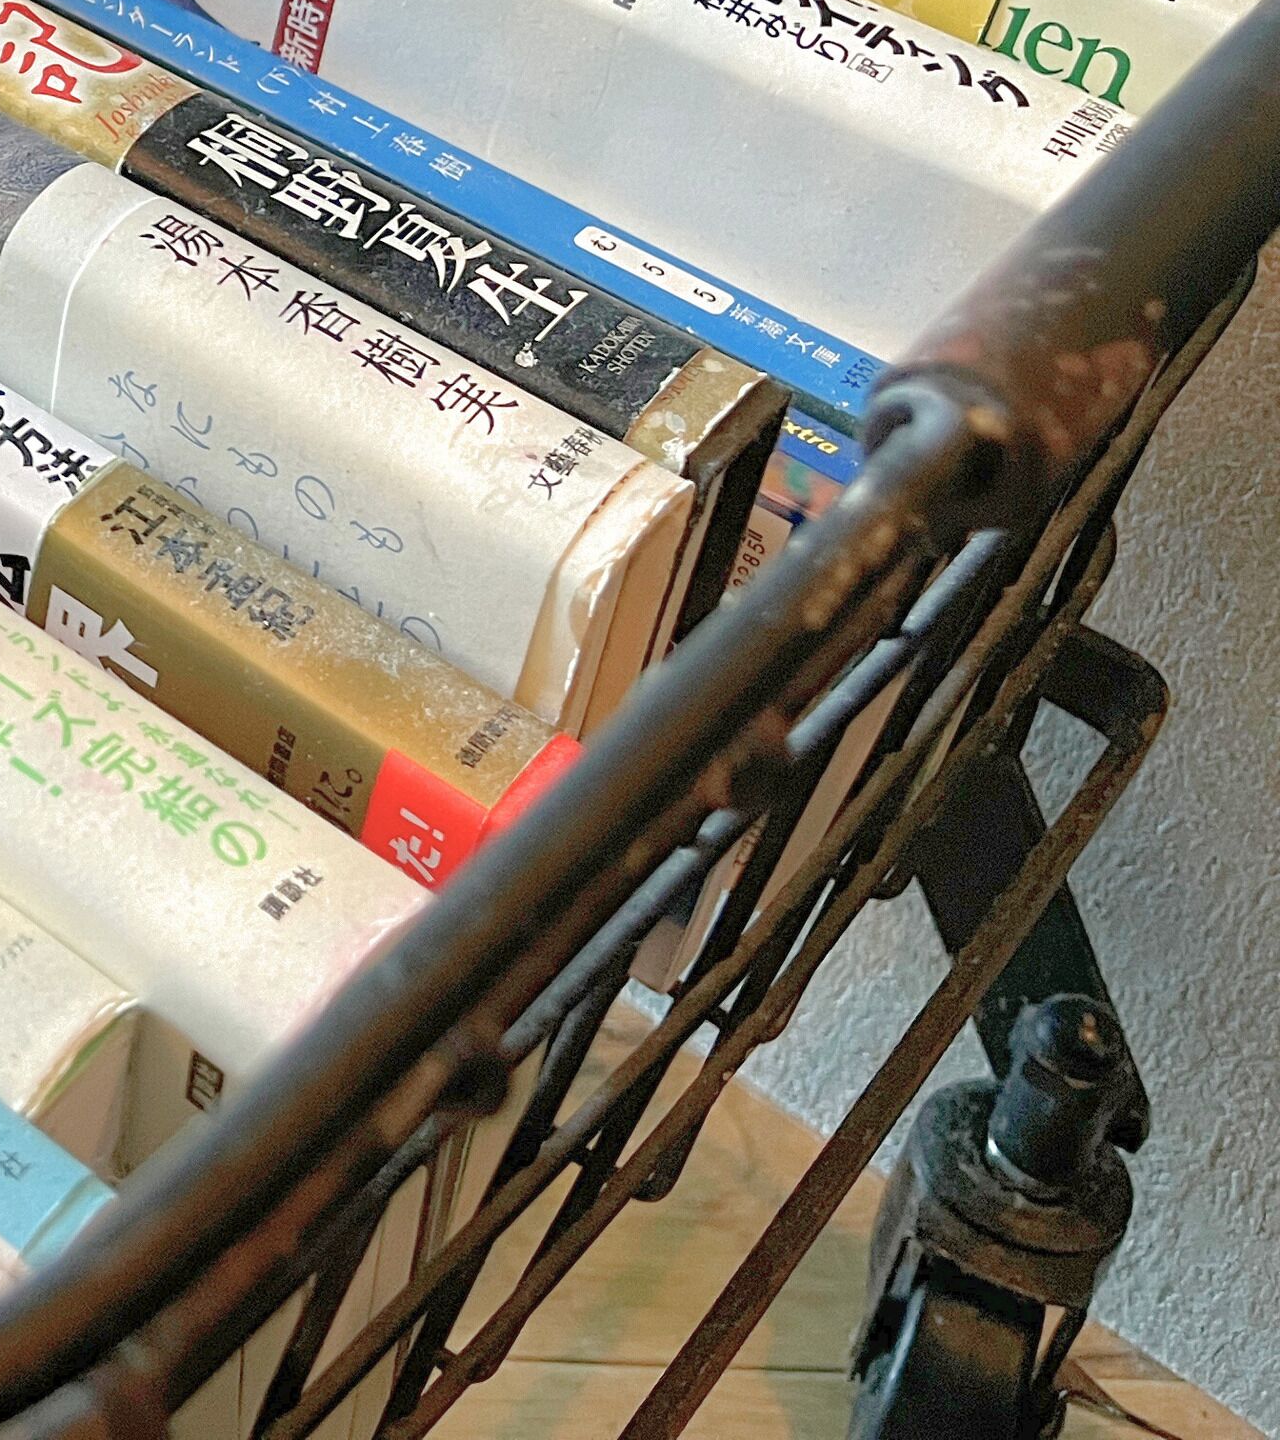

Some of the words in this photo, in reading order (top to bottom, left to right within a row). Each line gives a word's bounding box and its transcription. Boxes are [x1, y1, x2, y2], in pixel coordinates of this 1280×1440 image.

[308, 90, 472, 181] 村上春樹
[1043, 97, 1118, 162] 早川書房
[186, 113, 588, 343] 桐野夏生
[139, 214, 518, 437] 湯本香樹実
[578, 315, 643, 376] KADOKAWA
[606, 330, 657, 376] SHOTEN
[728, 303, 842, 370] 新潮文庫
[108, 367, 404, 557] なにものも
[527, 427, 606, 502] 文藝春秋
[782, 418, 840, 456] xtra
[101, 492, 314, 642] 江本孟紀
[258, 864, 324, 921] 講談社
